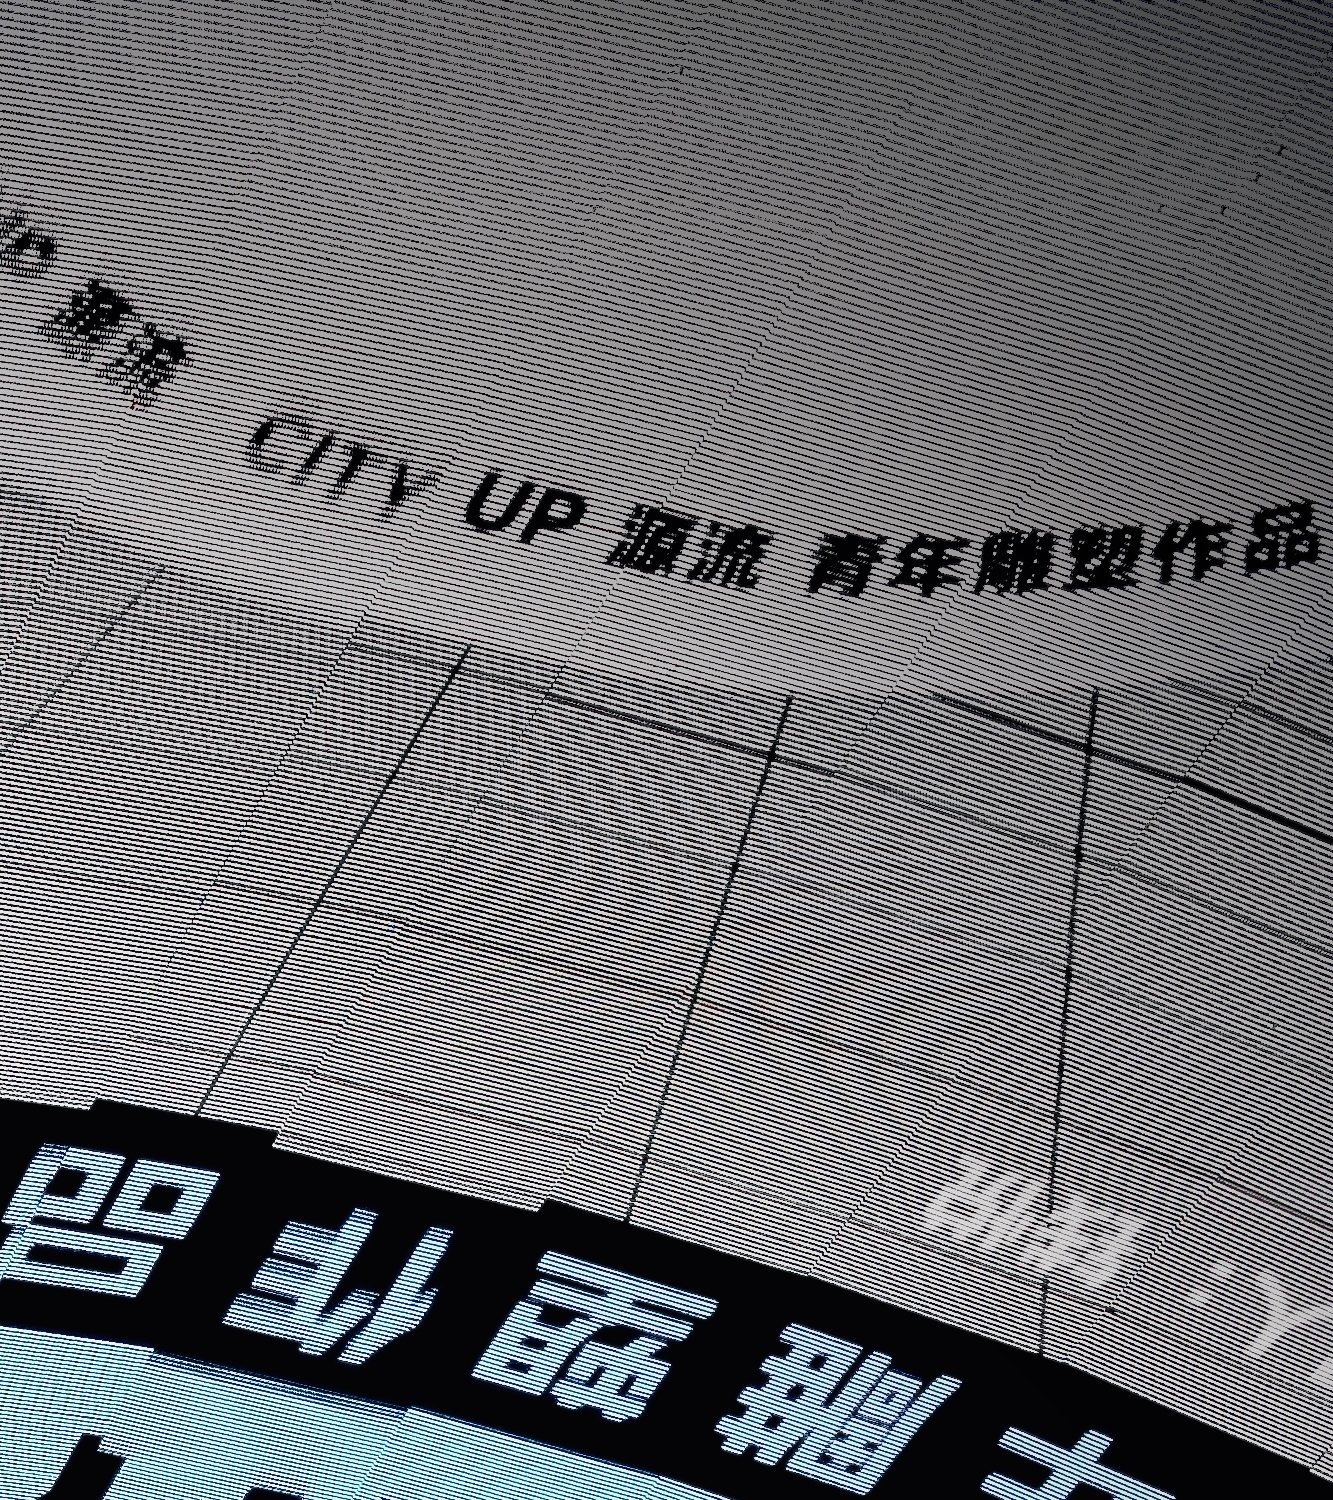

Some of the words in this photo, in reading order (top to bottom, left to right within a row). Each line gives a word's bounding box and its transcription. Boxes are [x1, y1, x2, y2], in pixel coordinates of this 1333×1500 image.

[245, 410, 439, 519] CITY
[461, 469, 589, 543] UP
[603, 500, 773, 592] 源流
[805, 500, 1323, 598] 青年雕塑作品
